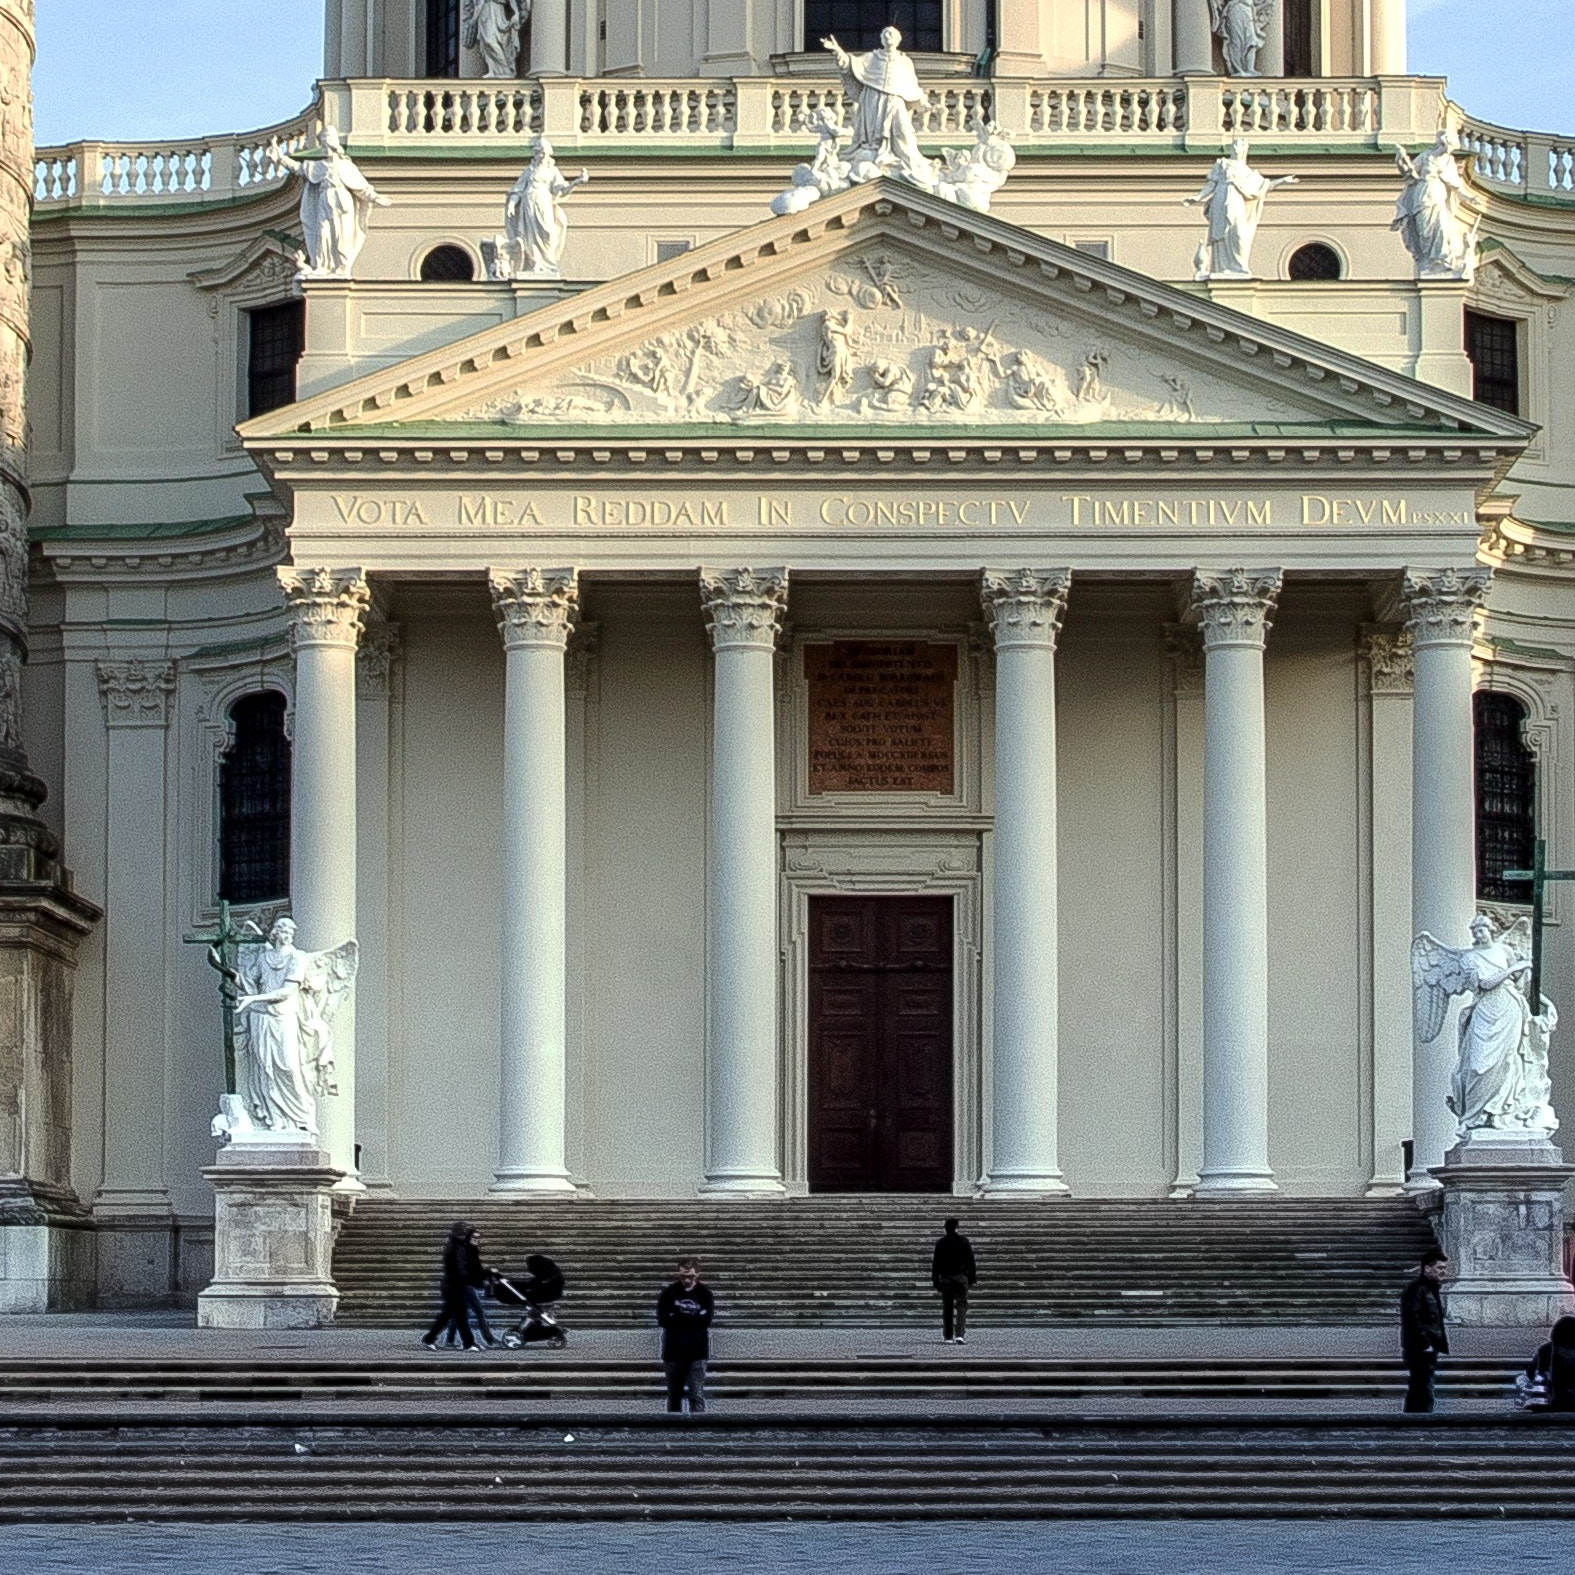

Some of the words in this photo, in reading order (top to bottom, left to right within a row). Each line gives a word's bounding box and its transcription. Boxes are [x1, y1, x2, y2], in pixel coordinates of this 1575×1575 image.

[330, 495, 428, 525] VOTA
[457, 496, 544, 525] MEA
[574, 496, 726, 525] REDDAM
[757, 497, 793, 525] IN
